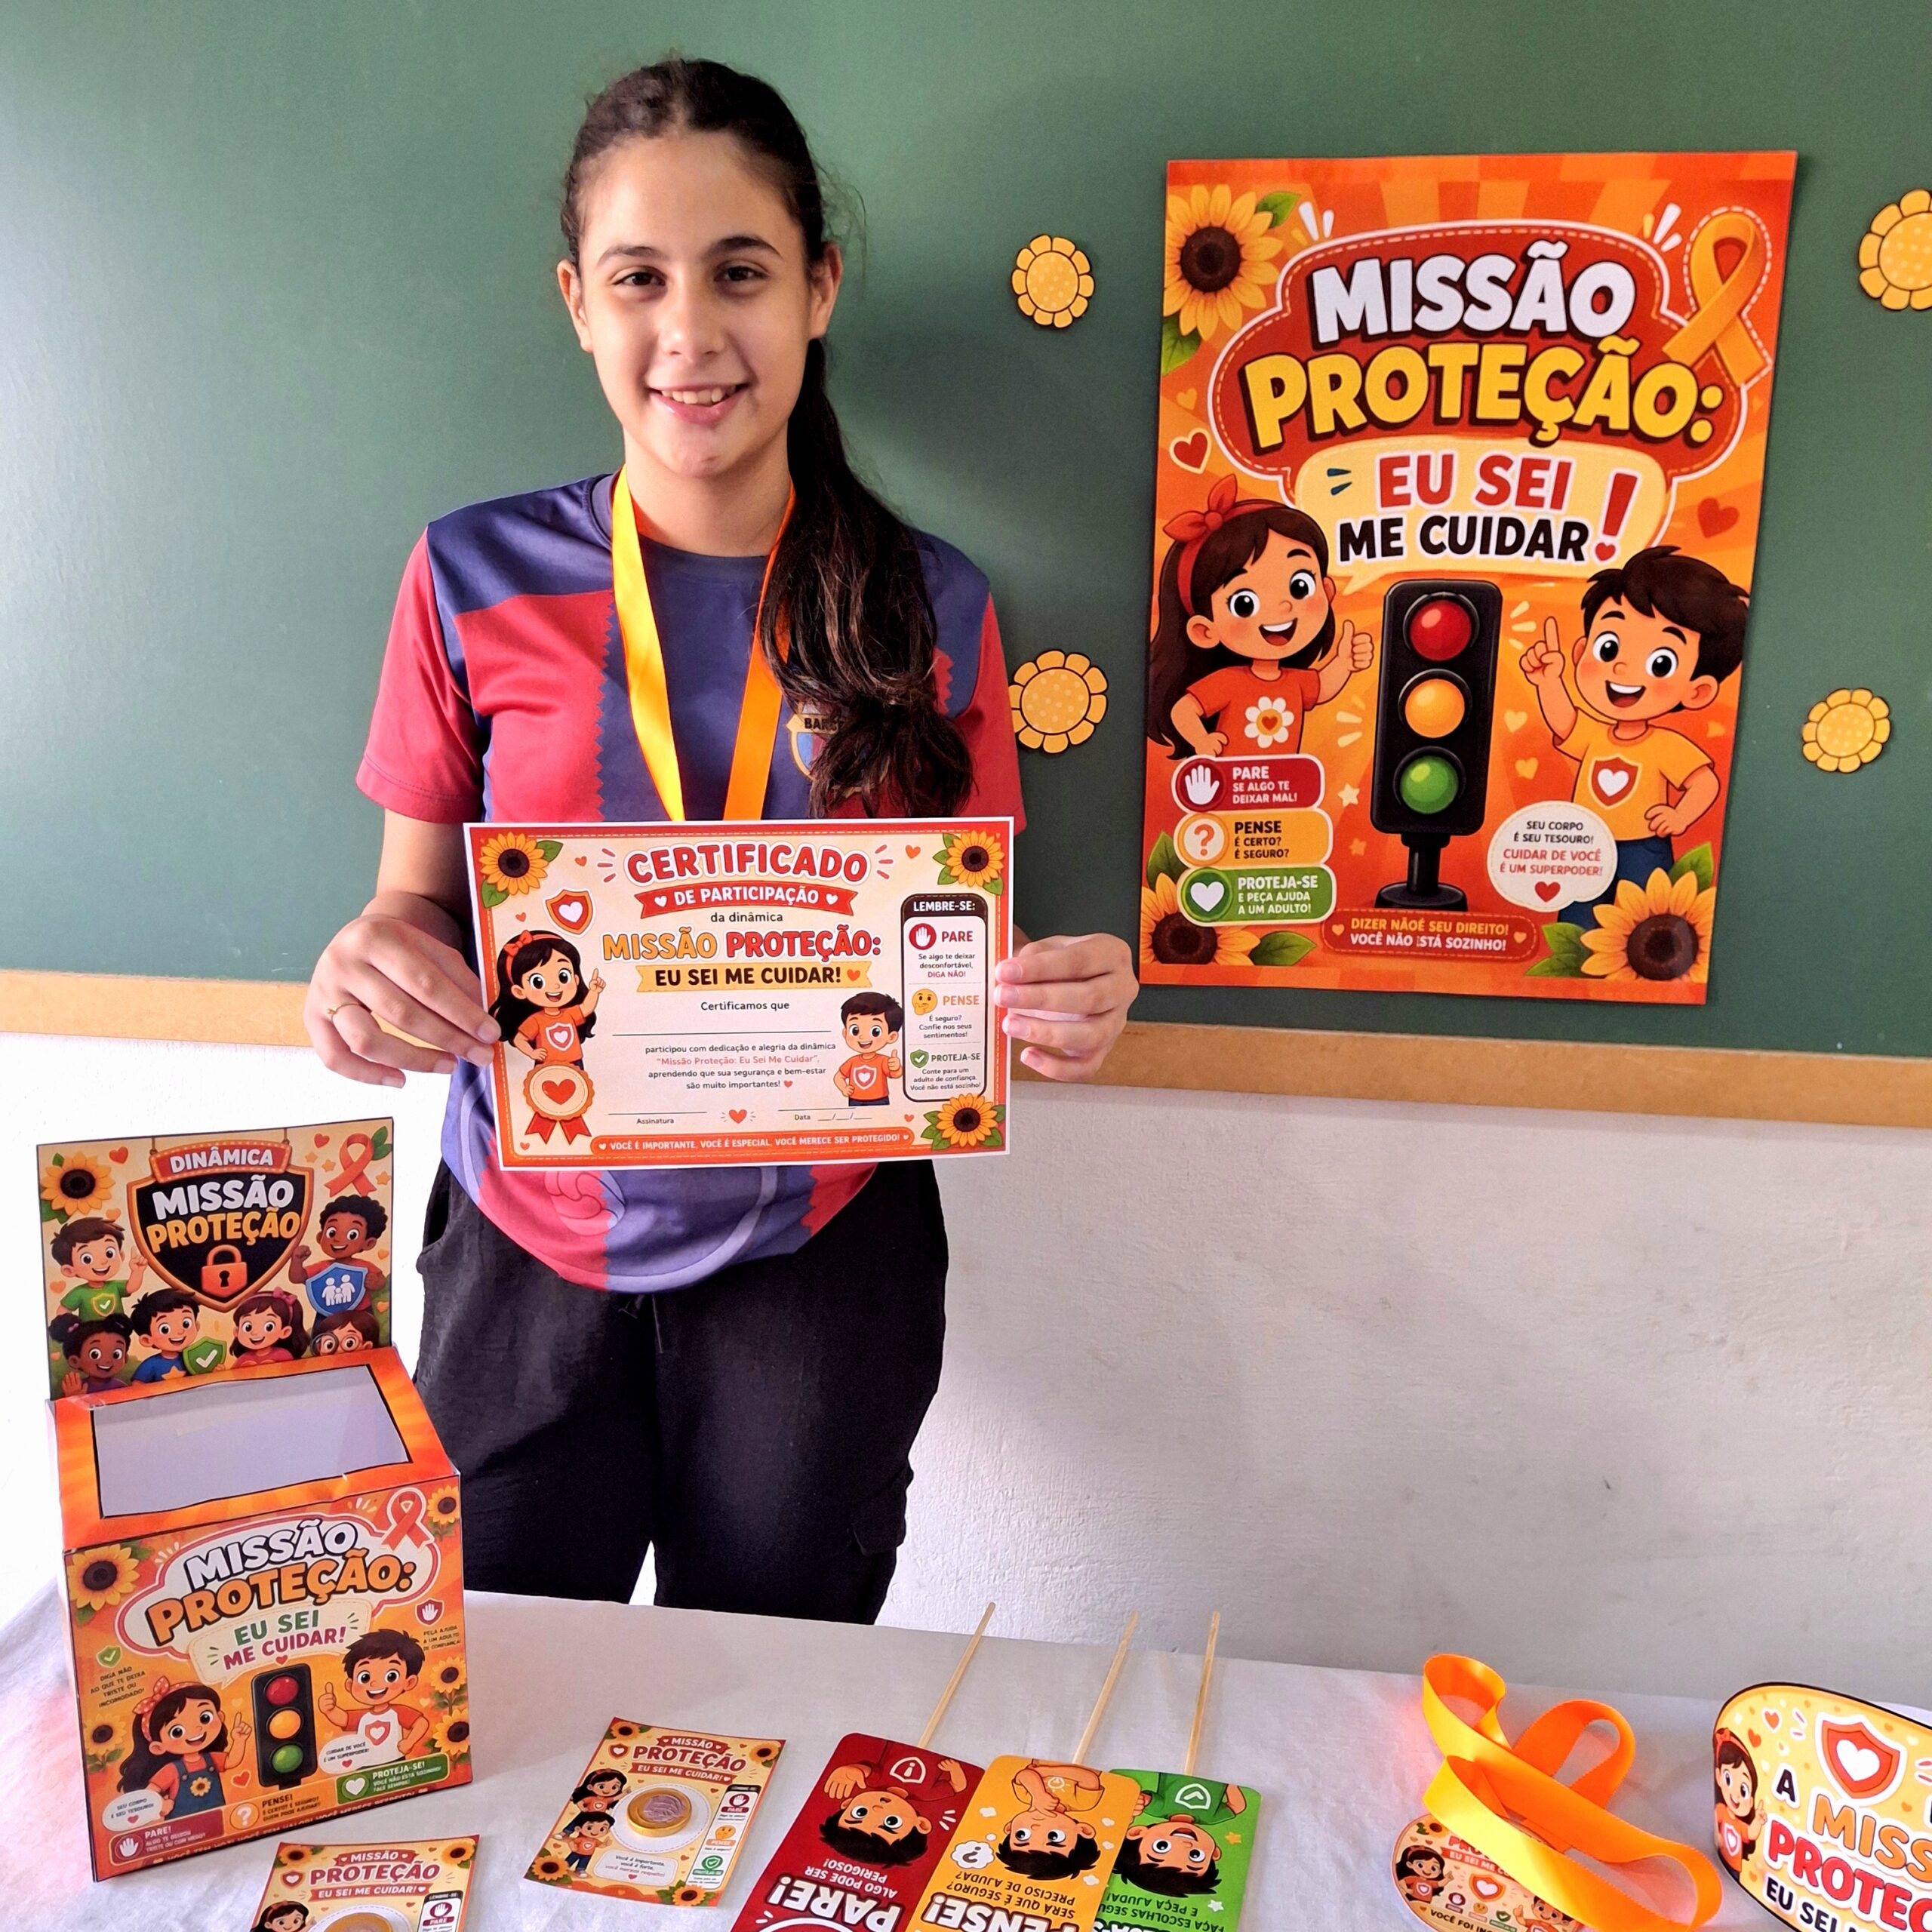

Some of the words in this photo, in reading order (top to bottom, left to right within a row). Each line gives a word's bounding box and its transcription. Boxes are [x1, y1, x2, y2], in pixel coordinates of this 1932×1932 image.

[1312, 240, 1636, 343] MISSÃO
[1244, 337, 1724, 450] PROTEÇÃO:
[1378, 453, 1454, 509] EU
[1475, 457, 1571, 512] SEI
[1338, 518, 1404, 562] ME
[1232, 766, 1269, 780] PARE
[1232, 782, 1244, 792] SE
[1247, 781, 1275, 792] ALGO
[1278, 780, 1290, 791] TE
[1232, 794, 1269, 804] DEIXAR
[1272, 792, 1297, 803] MAL!
[1234, 820, 1281, 834] PENSE
[1526, 820, 1546, 830] SEU
[1548, 821, 1583, 831] CORPO
[1235, 836, 1240, 847] É
[1244, 836, 1281, 846] CERTO?
[1513, 832, 1519, 842] É
[1522, 833, 1542, 843] SEU
[1545, 834, 1594, 844] TESOURO!
[1235, 849, 1240, 859] É
[1244, 849, 1289, 859] SEGURO?
[1503, 848, 1547, 860] CUIDAR
[1550, 850, 1567, 860] DE
[1570, 848, 1601, 862] VOCÊ
[627, 844, 868, 883] CERTIFICADO
[1500, 862, 1506, 873] É
[1509, 863, 1527, 874] UM
[1530, 864, 1603, 876] SUPERPODER!
[1238, 875, 1318, 890] PROTEJA-SE
[674, 889, 696, 906] DE
[700, 886, 819, 906] PARTICIPAÇÃO
[1238, 893, 1244, 903] E
[1247, 892, 1273, 904] PEÇA
[1275, 891, 1310, 902] AJUDA
[913, 900, 976, 912] LEMBRE-SE:
[1238, 905, 1245, 915] A
[1248, 904, 1265, 915] UM
[1267, 903, 1312, 914] ADULTO!
[710, 912, 725, 922] da
[728, 911, 783, 922] dinâmica
[1351, 918, 1387, 930] DIZER
[1429, 921, 1453, 933] SEU
[1456, 921, 1509, 935] DIREITO!
[603, 926, 718, 961] MISSÃO
[726, 924, 881, 962] PROTEÇÃO:
[941, 931, 974, 942] PARE
[1350, 932, 1383, 946] VOCÊ
[1386, 933, 1413, 946] NÃO
[1445, 937, 1506, 951] SOZINHO!
[928, 953, 943, 961] algo
[656, 969, 680, 986] EU
[688, 968, 718, 986] SEI
[725, 968, 755, 984] ME
[761, 966, 841, 983] CUIDAR!
[947, 970, 966, 978] NÃO!
[700, 1001, 768, 1011] Certificamos
[770, 1001, 790, 1012] que
[943, 995, 980, 1006] PENSE
[935, 1014, 962, 1023] seguro?
[645, 1045, 687, 1054] participou
[709, 1043, 749, 1054] dedicação
[758, 1043, 786, 1053] alegria
[800, 1041, 836, 1050] dinâmica
[931, 1052, 981, 1062] PROTEJA-SE
[648, 1069, 697, 1079] aprendendo
[700, 1070, 715, 1078] que
[734, 1069, 775, 1078] segurança
[784, 1067, 826, 1075] bem-estar
[703, 1081, 727, 1089] muito
[728, 1080, 780, 1091] importantes!
[610, 1140, 632, 1150] VOCÊ
[635, 1139, 640, 1149] É
[700, 1137, 722, 1149] VOCÊ
[724, 1137, 730, 1148] É
[775, 1135, 797, 1146] VOCÊ
[799, 1136, 832, 1146] MERECE
[834, 1135, 850, 1144] SER
[852, 1133, 900, 1143] PROTEGIDO!
[170, 1146, 273, 1173] DINÂMICA
[152, 1174, 294, 1220] MISSÃO
[146, 1207, 300, 1254] PROTEÇÃO
[184, 1518, 358, 1592] MISSÃO
[146, 1548, 417, 1647] PROTEÇÃO:
[234, 1620, 268, 1647] EU
[278, 1610, 319, 1634] SEI
[223, 1645, 257, 1671] ME
[262, 1626, 347, 1658] CUIDAR!
[671, 1737, 713, 1749] MISSÃO
[633, 1746, 746, 1772] PROTEÇÃO
[372, 1761, 425, 1780] PROTEJA-SE!
[685, 1770, 724, 1781] CUIDAR!
[1776, 1769, 1795, 1802] A
[262, 1794, 293, 1807] PENSE!
[145, 1826, 171, 1838] PARE!
[350, 1850, 398, 1863] MISSÃO
[310, 1860, 441, 1885] PROTEÇÃO
[804, 1866, 829, 1879] SER
[823, 1858, 888, 1884] PERIGOSO!
[829, 1874, 864, 1890] PODE
[955, 1870, 1003, 1887] AJUDA?
[318, 1890, 332, 1898] EU
[336, 1888, 352, 1897] SEI
[355, 1887, 371, 1895] ME
[374, 1885, 417, 1894] CUIDAR!
[864, 1883, 898, 1899] ALGO
[946, 1881, 1002, 1901] SEGURO?
[1004, 1881, 1021, 1892] DE
[1004, 1893, 1012, 1906] É
[1024, 1885, 1075, 1906] PRECISO
[1106, 1892, 1152, 1906] AJUDA!
[768, 1875, 901, 1932] PARE!
[1014, 1898, 1041, 1911] QUE
[1156, 1899, 1188, 1915] PEÇA
[1766, 1876, 1794, 1911] EU
[1799, 1901, 1838, 1932] SEI
[1044, 1903, 1076, 1919] SERÁ
[1131, 1908, 1192, 1928] ESCOLHAS
[1189, 1907, 1198, 1917] E
[1430, 1909, 1457, 1924] VOCÊ
[1457, 1917, 1474, 1930] FOI
